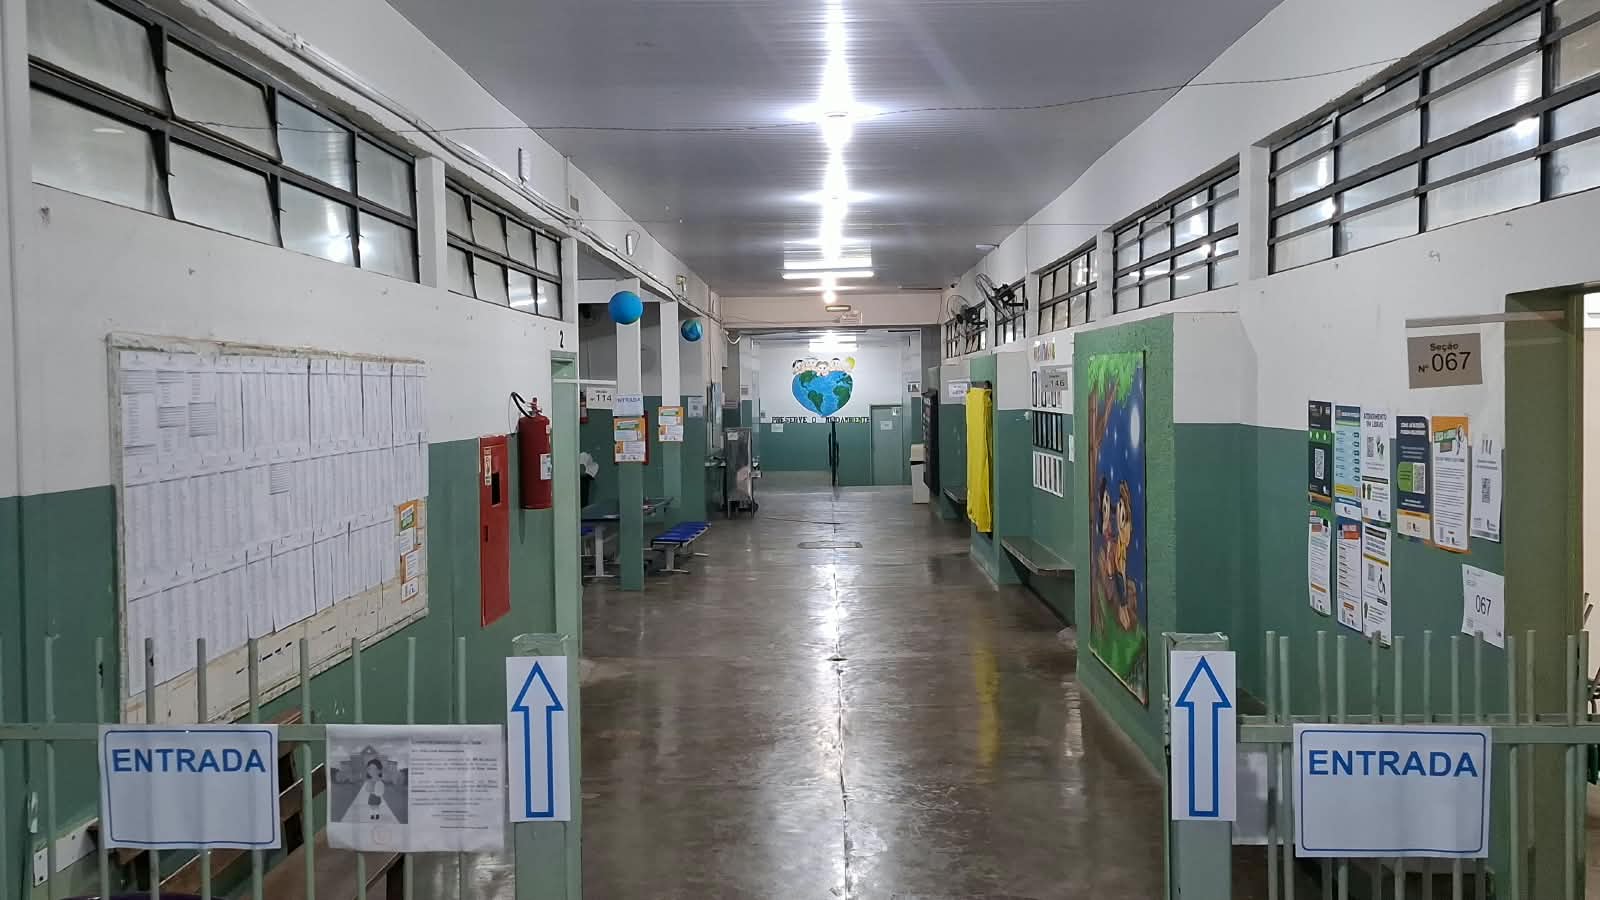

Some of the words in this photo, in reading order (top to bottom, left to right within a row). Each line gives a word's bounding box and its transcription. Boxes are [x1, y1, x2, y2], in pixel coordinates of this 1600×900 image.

[559, 329, 564, 348] 2
[1429, 341, 1459, 352] Seção
[1431, 351, 1472, 372] 067
[596, 393, 612, 401] 114
[771, 416, 808, 424] PRESERVE
[811, 416, 817, 424] O
[1475, 594, 1492, 616] 067
[112, 749, 266, 773] ENTRADA
[1308, 750, 1479, 777] ENTRADA
